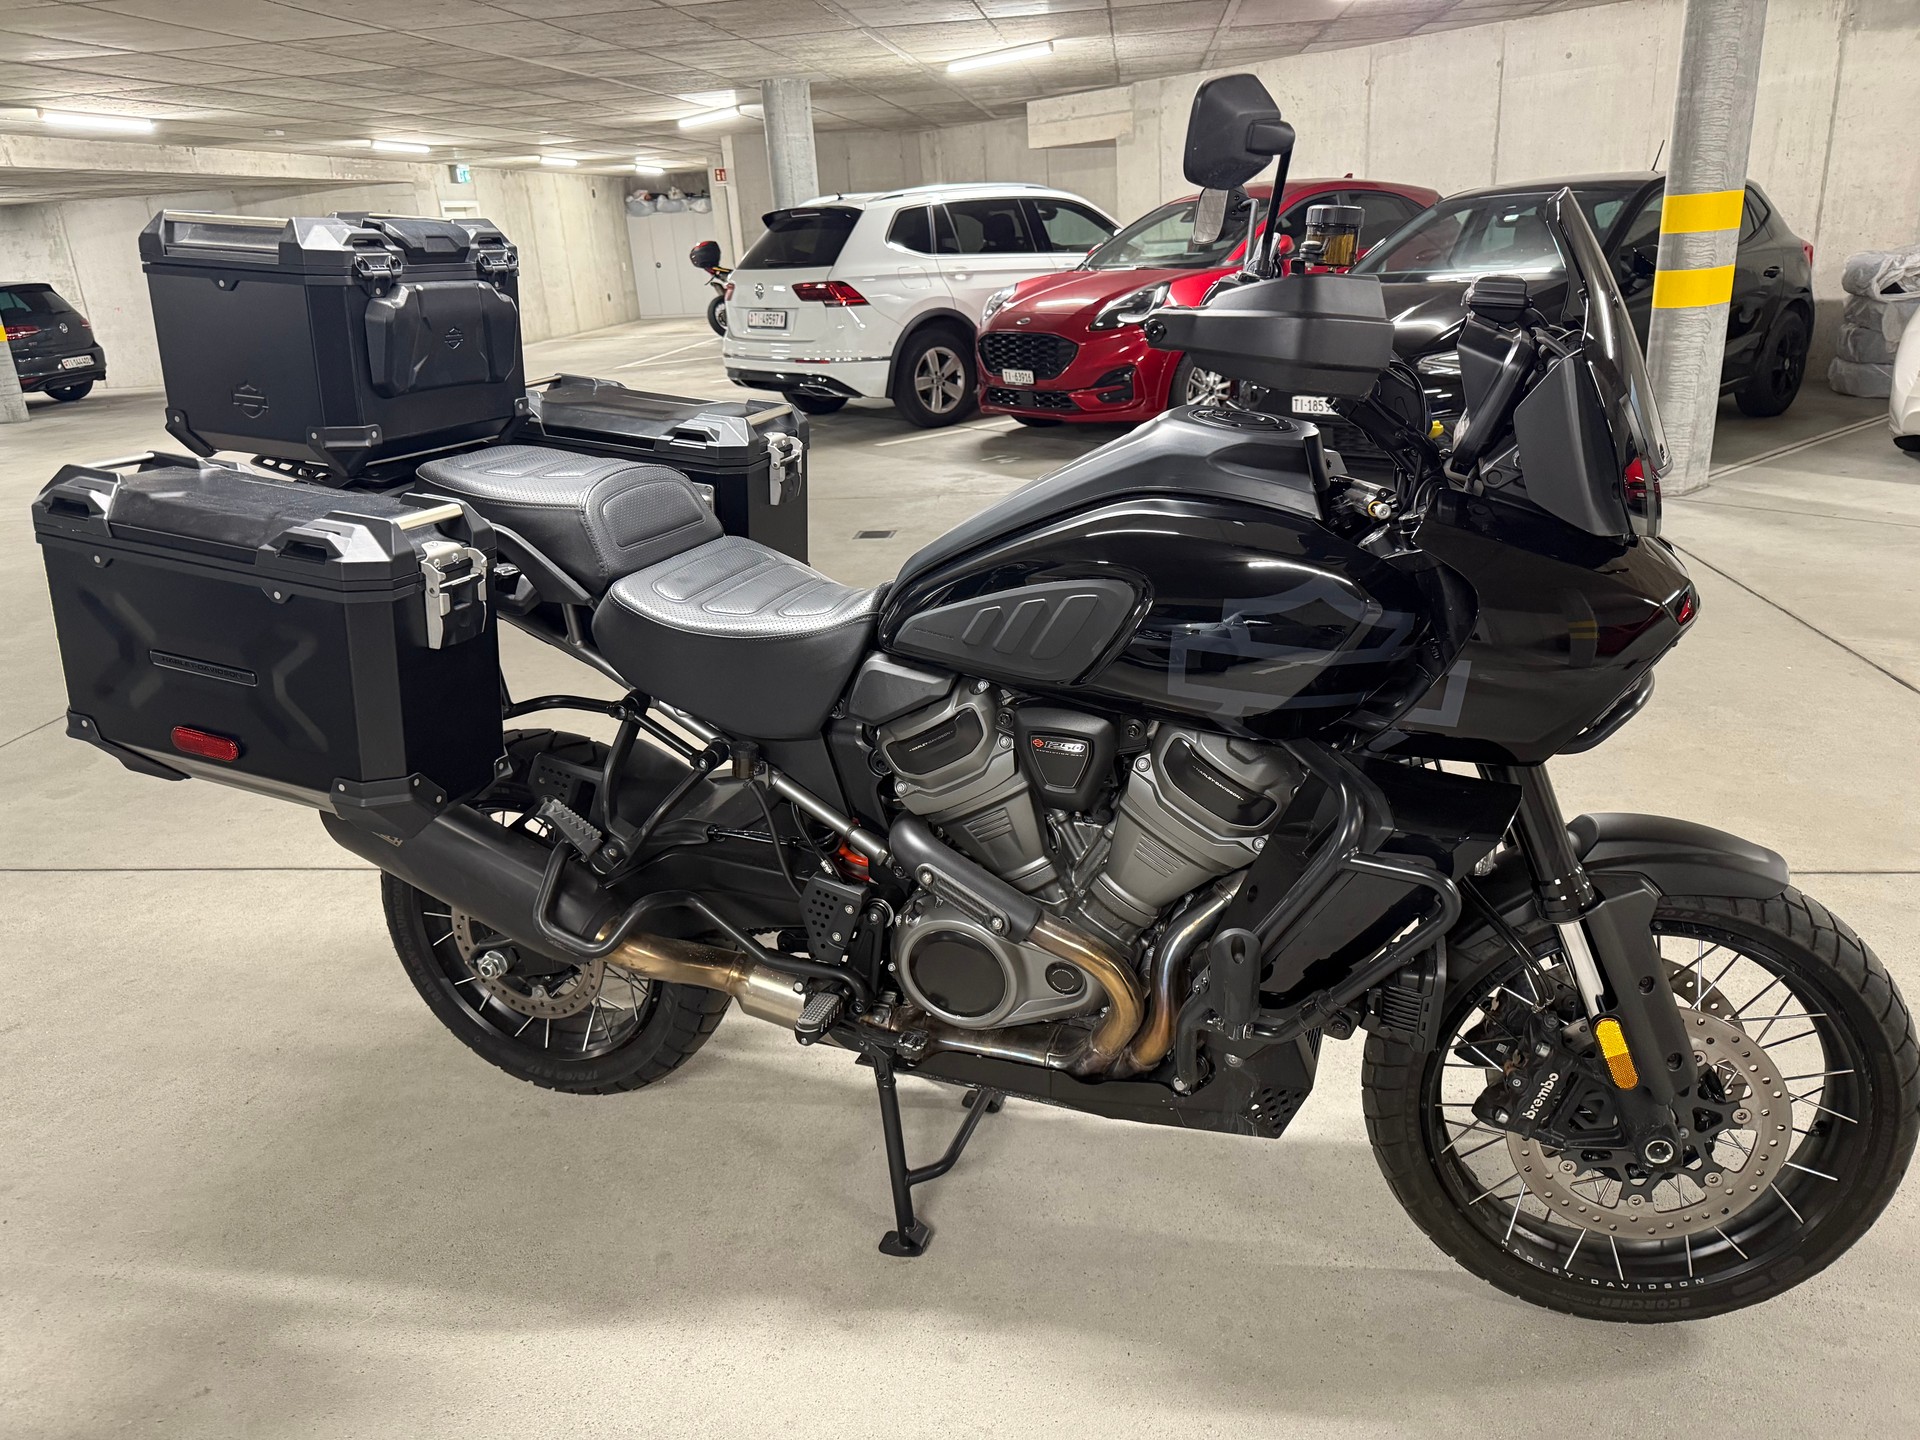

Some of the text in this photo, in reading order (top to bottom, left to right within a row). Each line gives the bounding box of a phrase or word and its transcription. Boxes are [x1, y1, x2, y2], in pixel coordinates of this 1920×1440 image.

[1196, 767, 1241, 799] HARLEY-DAVIDSON
[1522, 1072, 1559, 1120] brembo
[1501, 1239, 1705, 1291] HARLEY-DAVIDSON
